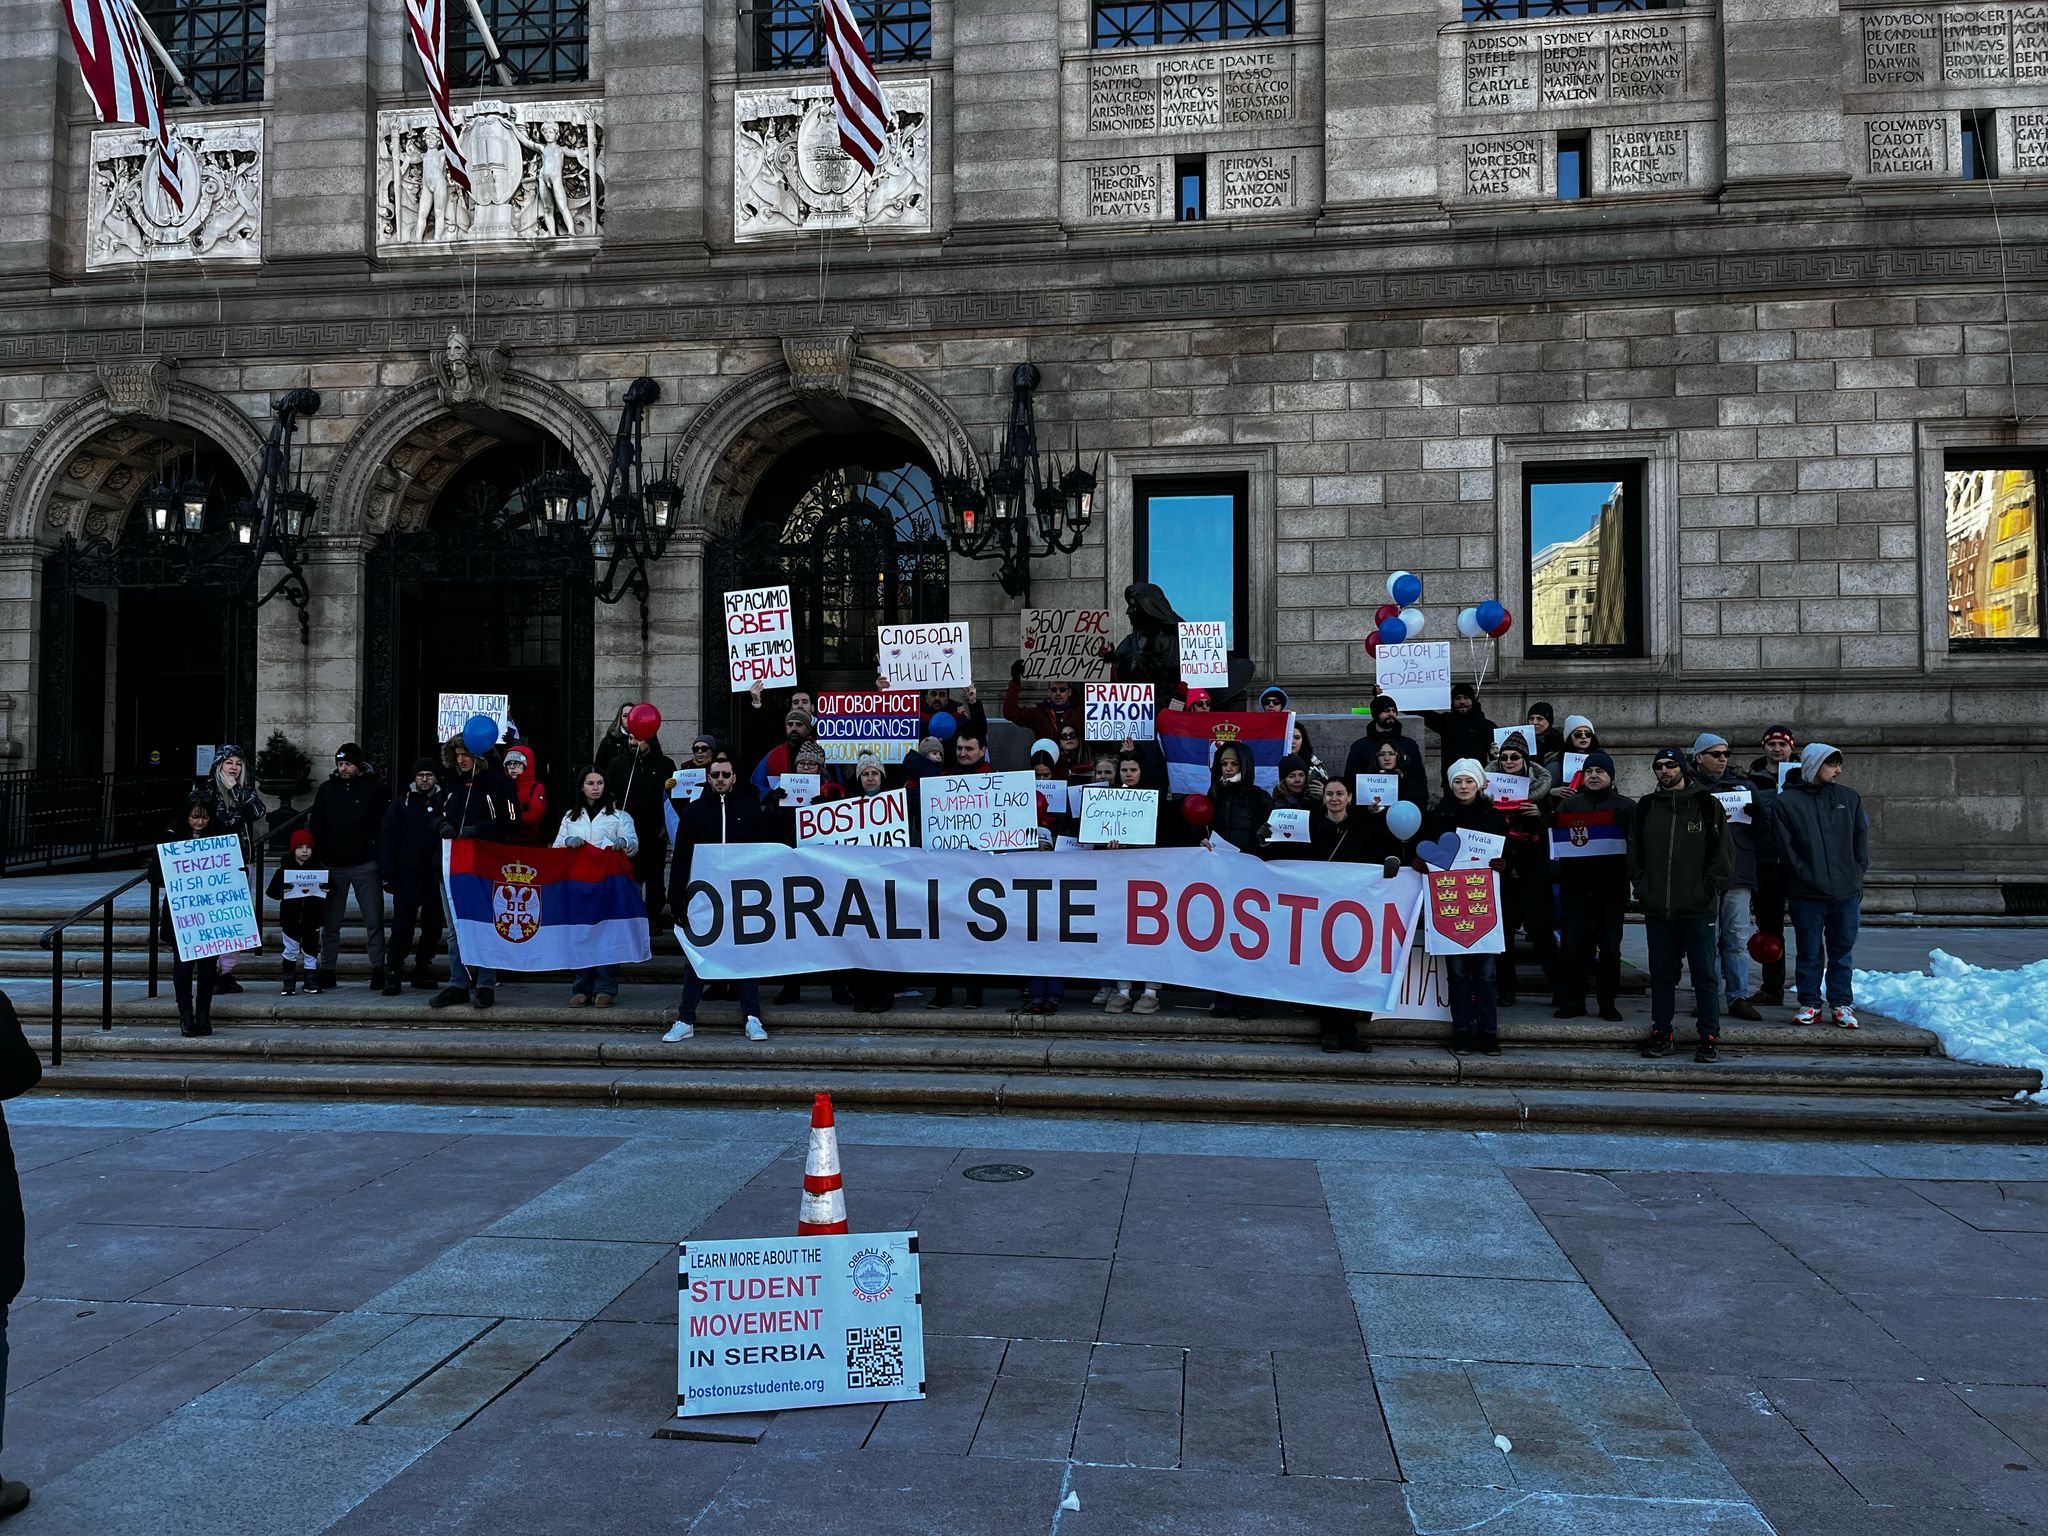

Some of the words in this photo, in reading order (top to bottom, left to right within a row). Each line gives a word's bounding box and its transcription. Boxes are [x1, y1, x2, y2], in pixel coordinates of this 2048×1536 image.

[1866, 14, 1934, 26] AVDVBON
[1943, 10, 2005, 24] HOOKER
[2014, 7, 2048, 20] AGA
[1544, 31, 1594, 46] SYDNEY
[1612, 26, 1669, 40] ARNOLD
[1867, 30, 1881, 41] DE
[1468, 36, 1528, 50] ADDISON
[1867, 43, 1917, 55] CUVIER
[2015, 36, 2048, 48] ARA
[1468, 50, 1516, 64] STEELE
[1544, 46, 1587, 60] DEFOE
[1945, 54, 2005, 66] BROWNE
[1162, 58, 1215, 72] HORACE
[1226, 54, 1275, 67] DANTE
[1544, 60, 1598, 74] BUNYAN
[1612, 54, 1678, 69] CHAPMAN
[1868, 57, 1920, 69] DARWIN
[1093, 64, 1139, 76] HOMER
[1227, 68, 1272, 80] TASSO
[1468, 66, 1508, 78] SWIFT
[1945, 68, 2008, 80] CONDILLAC
[1092, 78, 1142, 90] SAPPHO
[1163, 74, 1198, 86] OVID
[1612, 72, 1628, 84] DE
[1868, 71, 1924, 84] BVFFON
[1468, 78, 1530, 93] CARLYLE
[1612, 84, 1665, 98] FAIRFAX
[1092, 90, 1156, 104] ANACREON
[1225, 95, 1290, 109] METASTASIO
[1468, 94, 1509, 107] LAMB
[1544, 88, 1598, 102] WALTON
[1162, 114, 1218, 128] JUVENAL
[1226, 108, 1287, 122] LEOPARDI
[2018, 115, 2048, 126] BER
[1092, 118, 1156, 132] SIMONIDES
[1871, 118, 1942, 132] COLVMBVS
[1871, 133, 1924, 146] CABOT
[1469, 140, 1534, 154] JOHNSON
[1613, 144, 1676, 158] RABELAIS
[1226, 157, 1273, 170] FIRDVSI
[1613, 158, 1660, 172] RACINE
[1873, 160, 1933, 173] RALEIGH
[1093, 164, 1140, 178] HESIOD
[1225, 168, 1291, 183] CAMOENS
[1469, 167, 1530, 182] CAXTON
[1225, 182, 1288, 196] MANZONI
[1469, 181, 1509, 194] AMES
[1092, 190, 1156, 202] MENANDER
[1226, 196, 1282, 210] SPINOZA
[1093, 202, 1150, 216] PLAVTVS
[411, 294, 460, 310] FREE
[505, 292, 545, 307] ALL
[726, 589, 788, 614] КРАСИМО
[728, 609, 789, 635] СВЕТ
[1030, 610, 1076, 634] ЗБОГ
[1074, 611, 1110, 634] ВАС
[881, 626, 962, 646] СЛОБОДА
[1180, 624, 1221, 636] ЗАКОН
[1029, 634, 1106, 657] ДАЛЕКО
[1181, 636, 1223, 648] ПИШЕШ
[731, 645, 739, 660] А
[1182, 650, 1198, 661] ДА
[1204, 649, 1220, 660] ГА
[1379, 644, 1430, 659] БОСТОН
[1436, 644, 1448, 659] ЈЕ
[732, 655, 794, 682] СРБИЈУ
[1022, 658, 1046, 680] ОД
[1043, 656, 1106, 680] ДОМА
[1380, 667, 1450, 686] СТУДЕНТЕ!
[1086, 684, 1154, 702] PRAVDA
[817, 694, 920, 715] ОДГОВОРНОСТ
[1086, 702, 1154, 720] ZAKON
[816, 718, 920, 737] ODGOVORNOST
[1086, 720, 1153, 740] MORAL
[946, 778, 970, 793] DA
[978, 773, 1004, 790] JE
[1496, 776, 1518, 784] Hvala
[994, 792, 1029, 807] LAKO
[1088, 790, 1157, 803] WARNING:
[800, 792, 905, 840] BOSTON
[1086, 802, 1144, 822] Corruption
[1278, 812, 1298, 820] Hvala
[928, 813, 982, 832] PUMPAO
[1100, 821, 1127, 836] Kills
[163, 844, 180, 856] NE
[184, 835, 238, 854] SPUSTAMO
[932, 834, 970, 850] ONDA
[980, 827, 1038, 848] SVAKO!!!
[1468, 833, 1492, 844] Hvala
[1469, 846, 1486, 854] vam
[172, 854, 232, 874] TENZIJE
[187, 876, 203, 890] SA
[208, 872, 232, 886] OVE
[172, 894, 216, 911] STRANE
[216, 888, 248, 906] GRANE
[208, 904, 253, 924] BOSTON
[682, 876, 940, 947] OBRALI
[966, 877, 1098, 943] STE
[1126, 879, 1407, 974] BOSTON
[182, 932, 192, 944] U
[691, 1252, 727, 1268] LEARN
[730, 1251, 760, 1267] MORE
[762, 1250, 798, 1265] ABOUT
[801, 1248, 822, 1264] THE
[848, 1248, 879, 1268] OBRALI
[880, 1250, 896, 1266] STE
[691, 1274, 822, 1303] STUDENT
[852, 1286, 894, 1303] BOSTON
[690, 1308, 824, 1338] MOVEMENT
[690, 1350, 715, 1368] IN
[725, 1343, 826, 1366] SERBIA
[688, 1378, 824, 1398] bostonuzstudente.org
